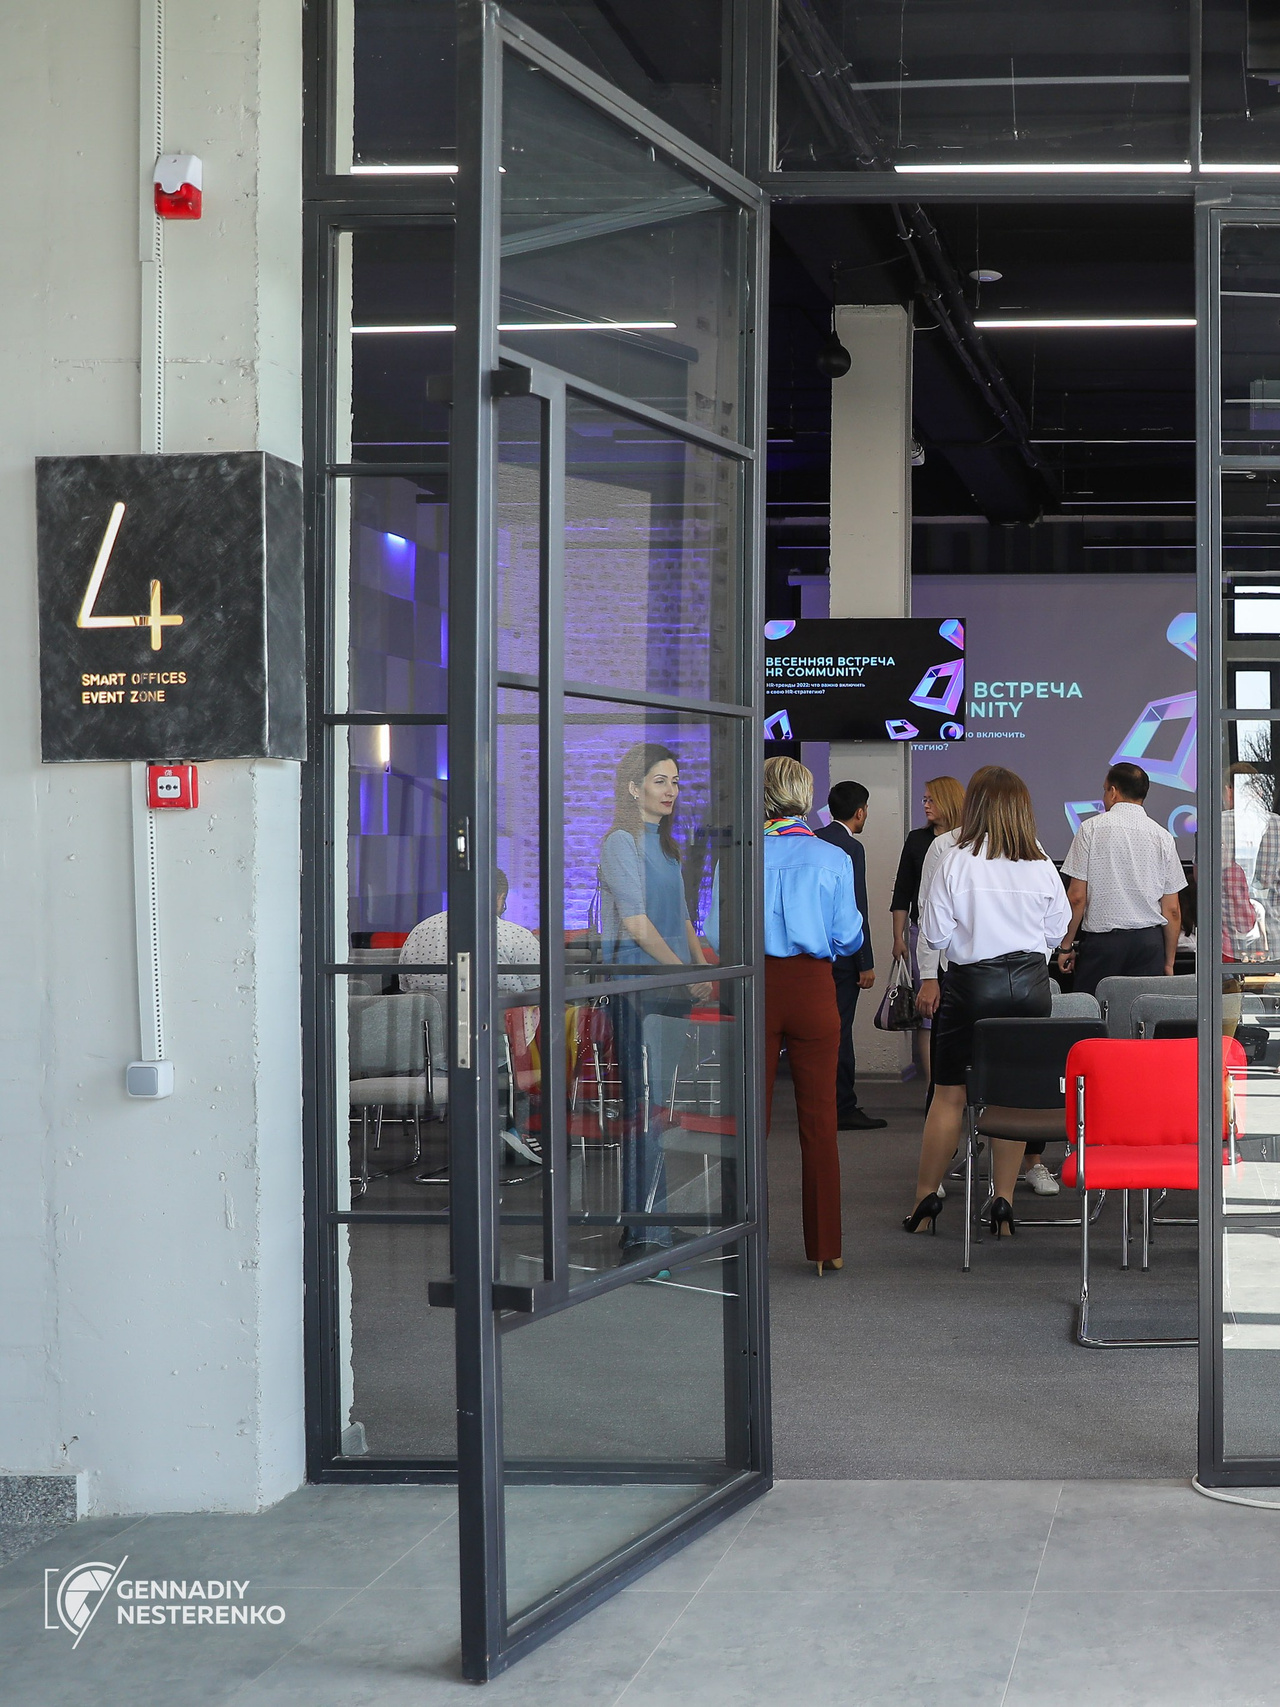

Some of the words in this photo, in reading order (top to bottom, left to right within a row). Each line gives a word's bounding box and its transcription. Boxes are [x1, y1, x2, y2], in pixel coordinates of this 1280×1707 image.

[76, 501, 184, 651] 4
[765, 656, 834, 667] ВЕСЕННЯЯ
[837, 656, 896, 667] ВСТРЕЧА
[81, 673, 126, 687] SMART
[131, 671, 187, 685] OFFICES
[765, 667, 783, 677] HR
[786, 667, 864, 677] COMMUNITY
[81, 690, 125, 704] EVENT
[130, 690, 165, 703] ZONE
[974, 681, 1083, 699] ВСТРЕЧА
[965, 701, 1023, 718] NITY
